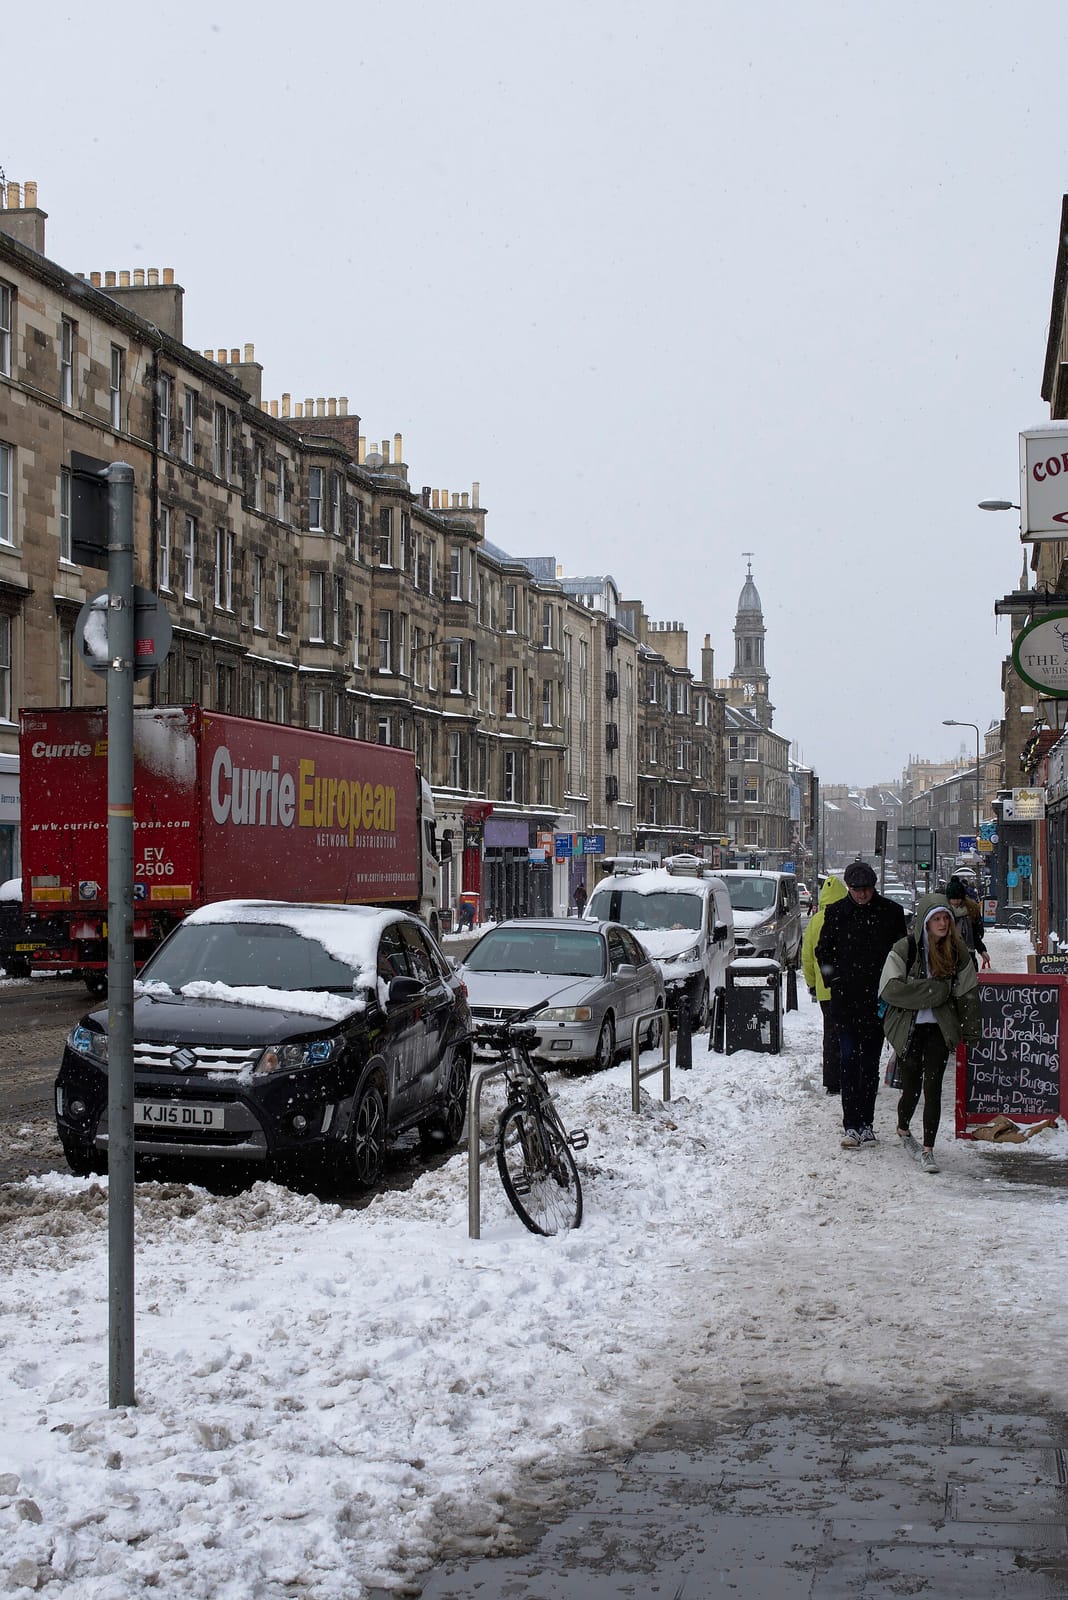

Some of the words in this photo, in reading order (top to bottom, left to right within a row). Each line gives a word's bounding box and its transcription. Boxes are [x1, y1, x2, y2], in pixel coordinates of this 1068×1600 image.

[1025, 655, 1059, 666] THE
[31, 741, 92, 757] Currie
[210, 746, 295, 827] Currie
[299, 759, 396, 848] European
[31, 820, 190, 831] www.currie-pean.com
[317, 833, 348, 848] NETWORK
[356, 835, 397, 848] DISTRIBUTION
[144, 848, 164, 861] EV
[136, 863, 174, 876] 2506
[1001, 1004, 1043, 1023] Cafe
[970, 1086, 1003, 1104] Lunch
[1013, 1091, 1047, 1108] Dinner
[144, 1105, 177, 1123] KJ15
[182, 1108, 213, 1125] DLD
[976, 1102, 1000, 1113] from
